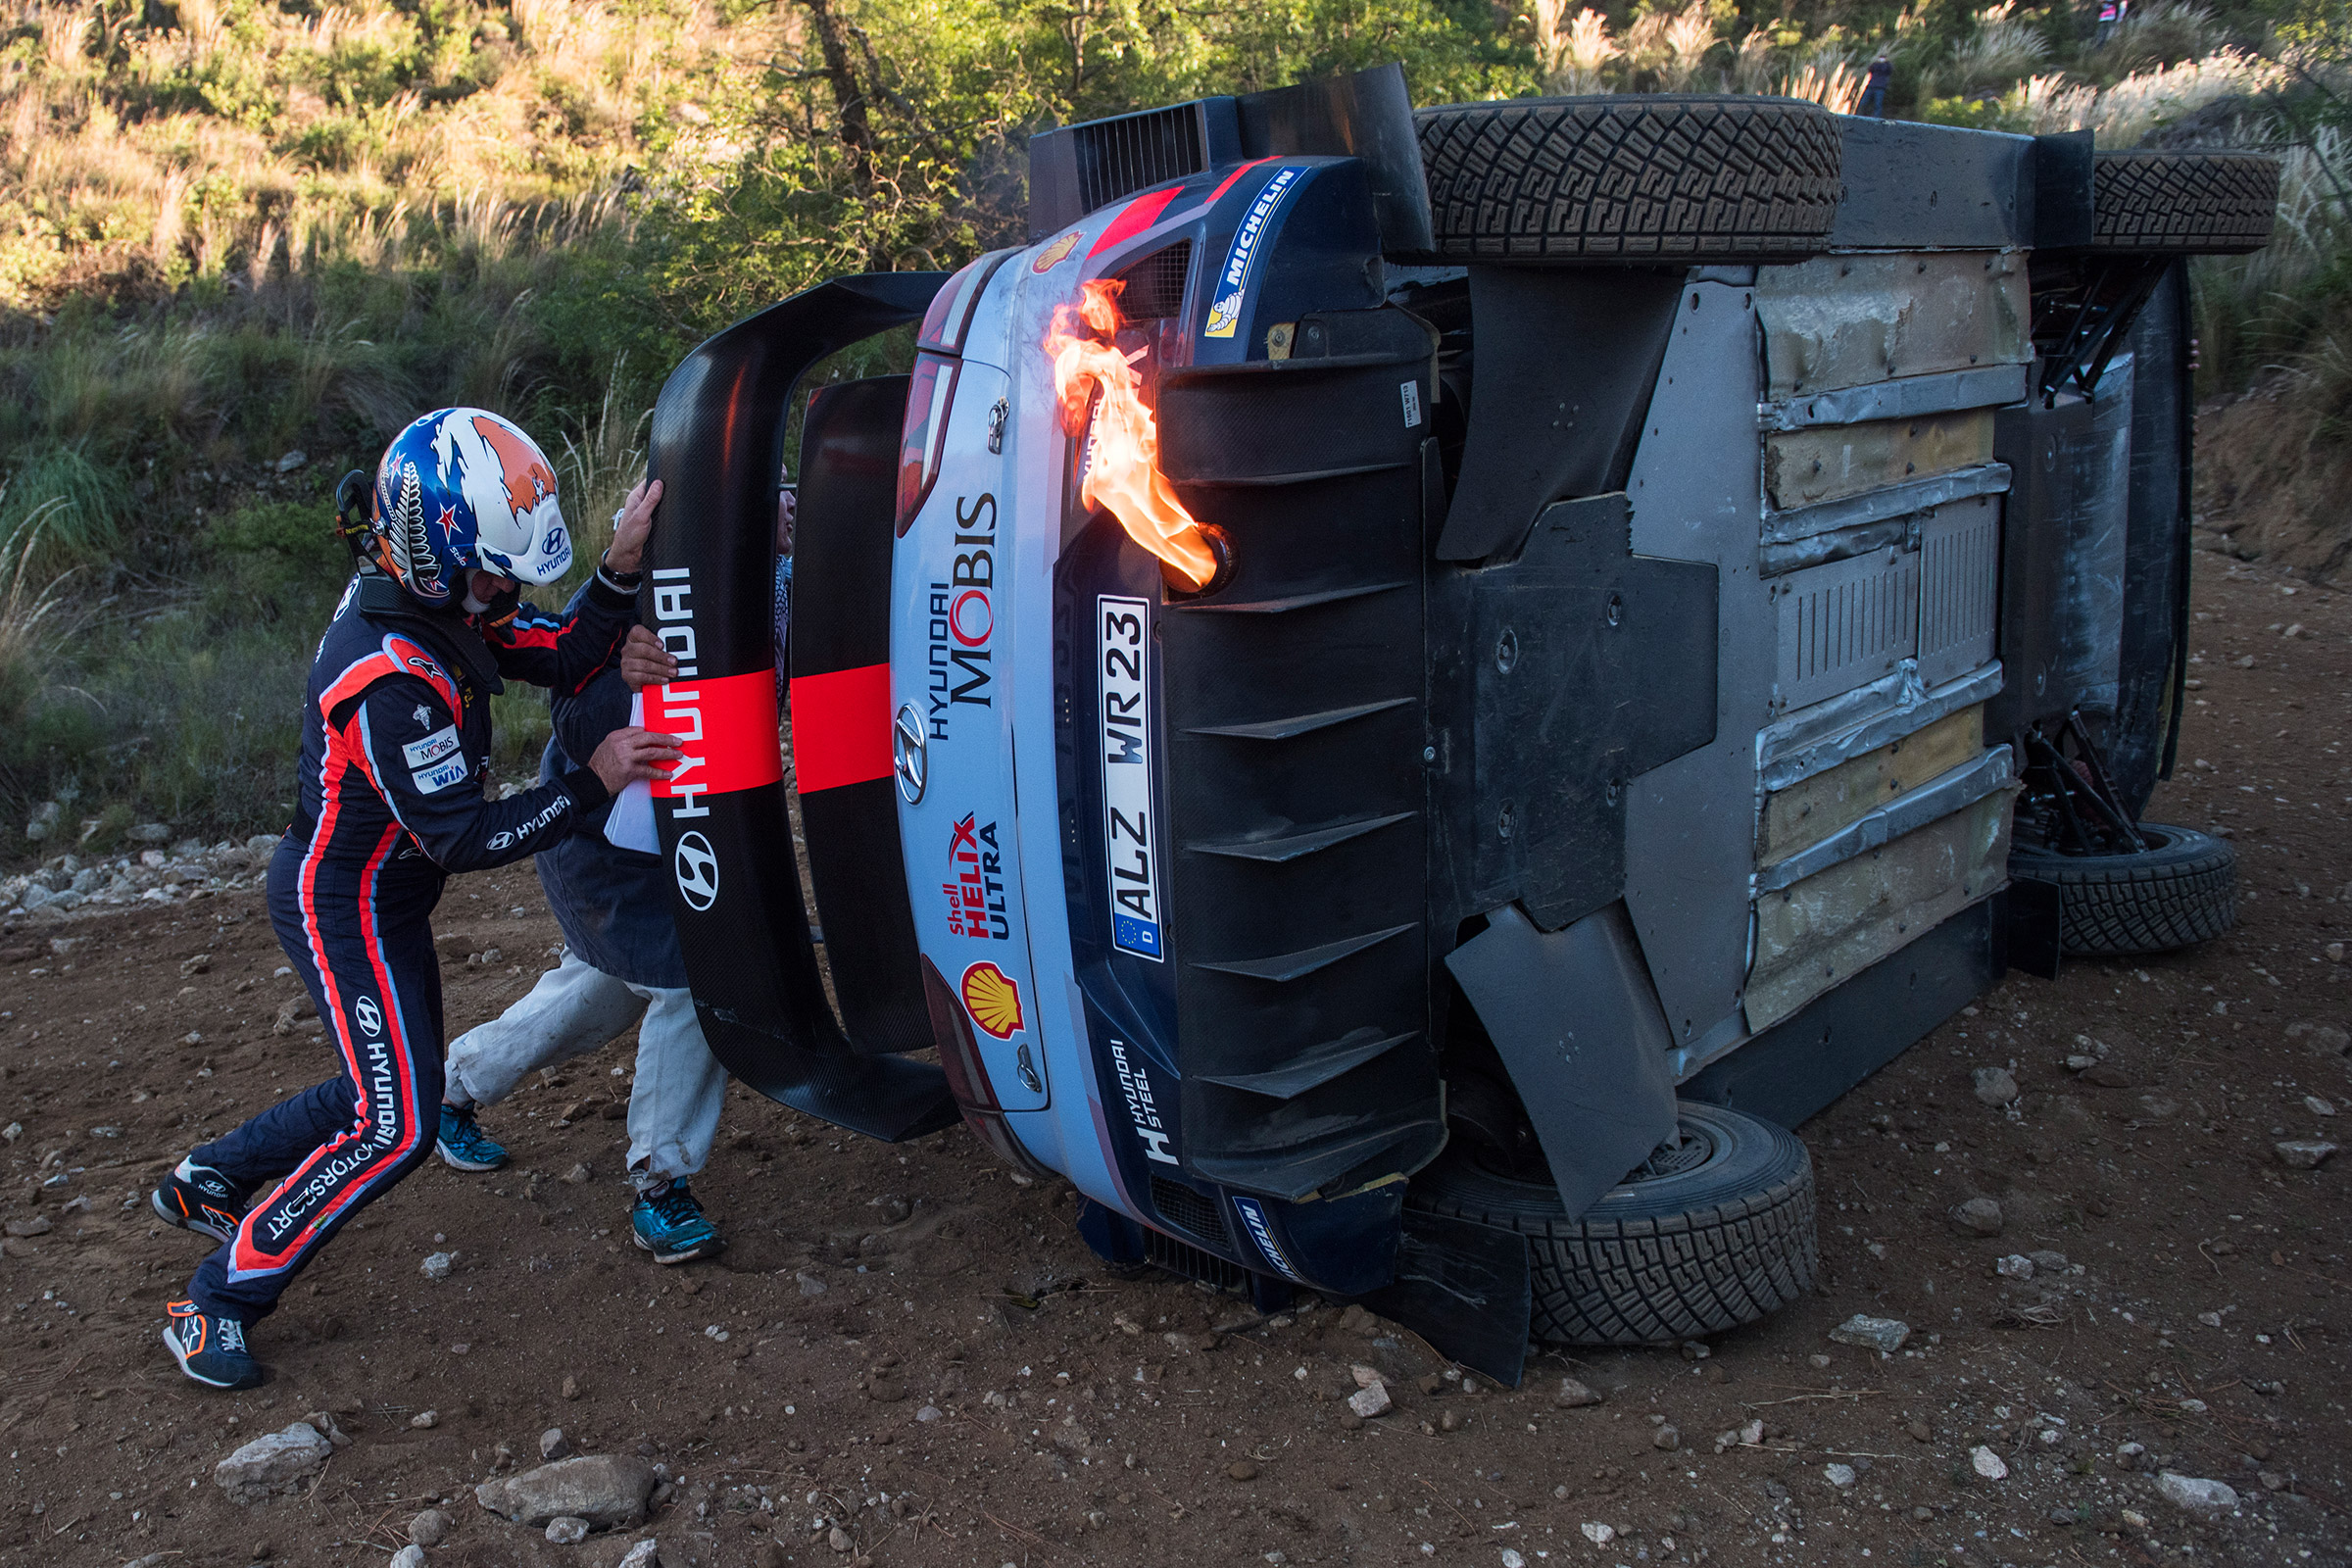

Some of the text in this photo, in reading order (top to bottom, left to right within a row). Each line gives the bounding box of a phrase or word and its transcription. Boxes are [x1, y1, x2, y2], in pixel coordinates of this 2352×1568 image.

[1226, 170, 1295, 286] MICHELIN
[536, 546, 571, 576] HYUNDAI
[949, 492, 998, 710] MOBIS
[653, 567, 710, 818] HYUNDAI
[928, 582, 950, 741] HYUNDAI
[410, 738, 437, 753] HYUNDAI
[417, 764, 450, 780] HYUNDAI
[420, 736, 454, 760] MOBIS
[1105, 612, 1152, 920] ALZ WR 23
[515, 795, 571, 840] HYUNDAI
[942, 883, 965, 936] Shell
[951, 813, 990, 940] HELIX
[979, 820, 1009, 941] ULTRA
[1142, 930, 1153, 944] D
[367, 1042, 397, 1145] HYUNDAI
[1110, 1039, 1140, 1125] HYUNDAI
[1133, 1067, 1162, 1129] STEEL
[198, 1183, 228, 1199] HYUNDAI
